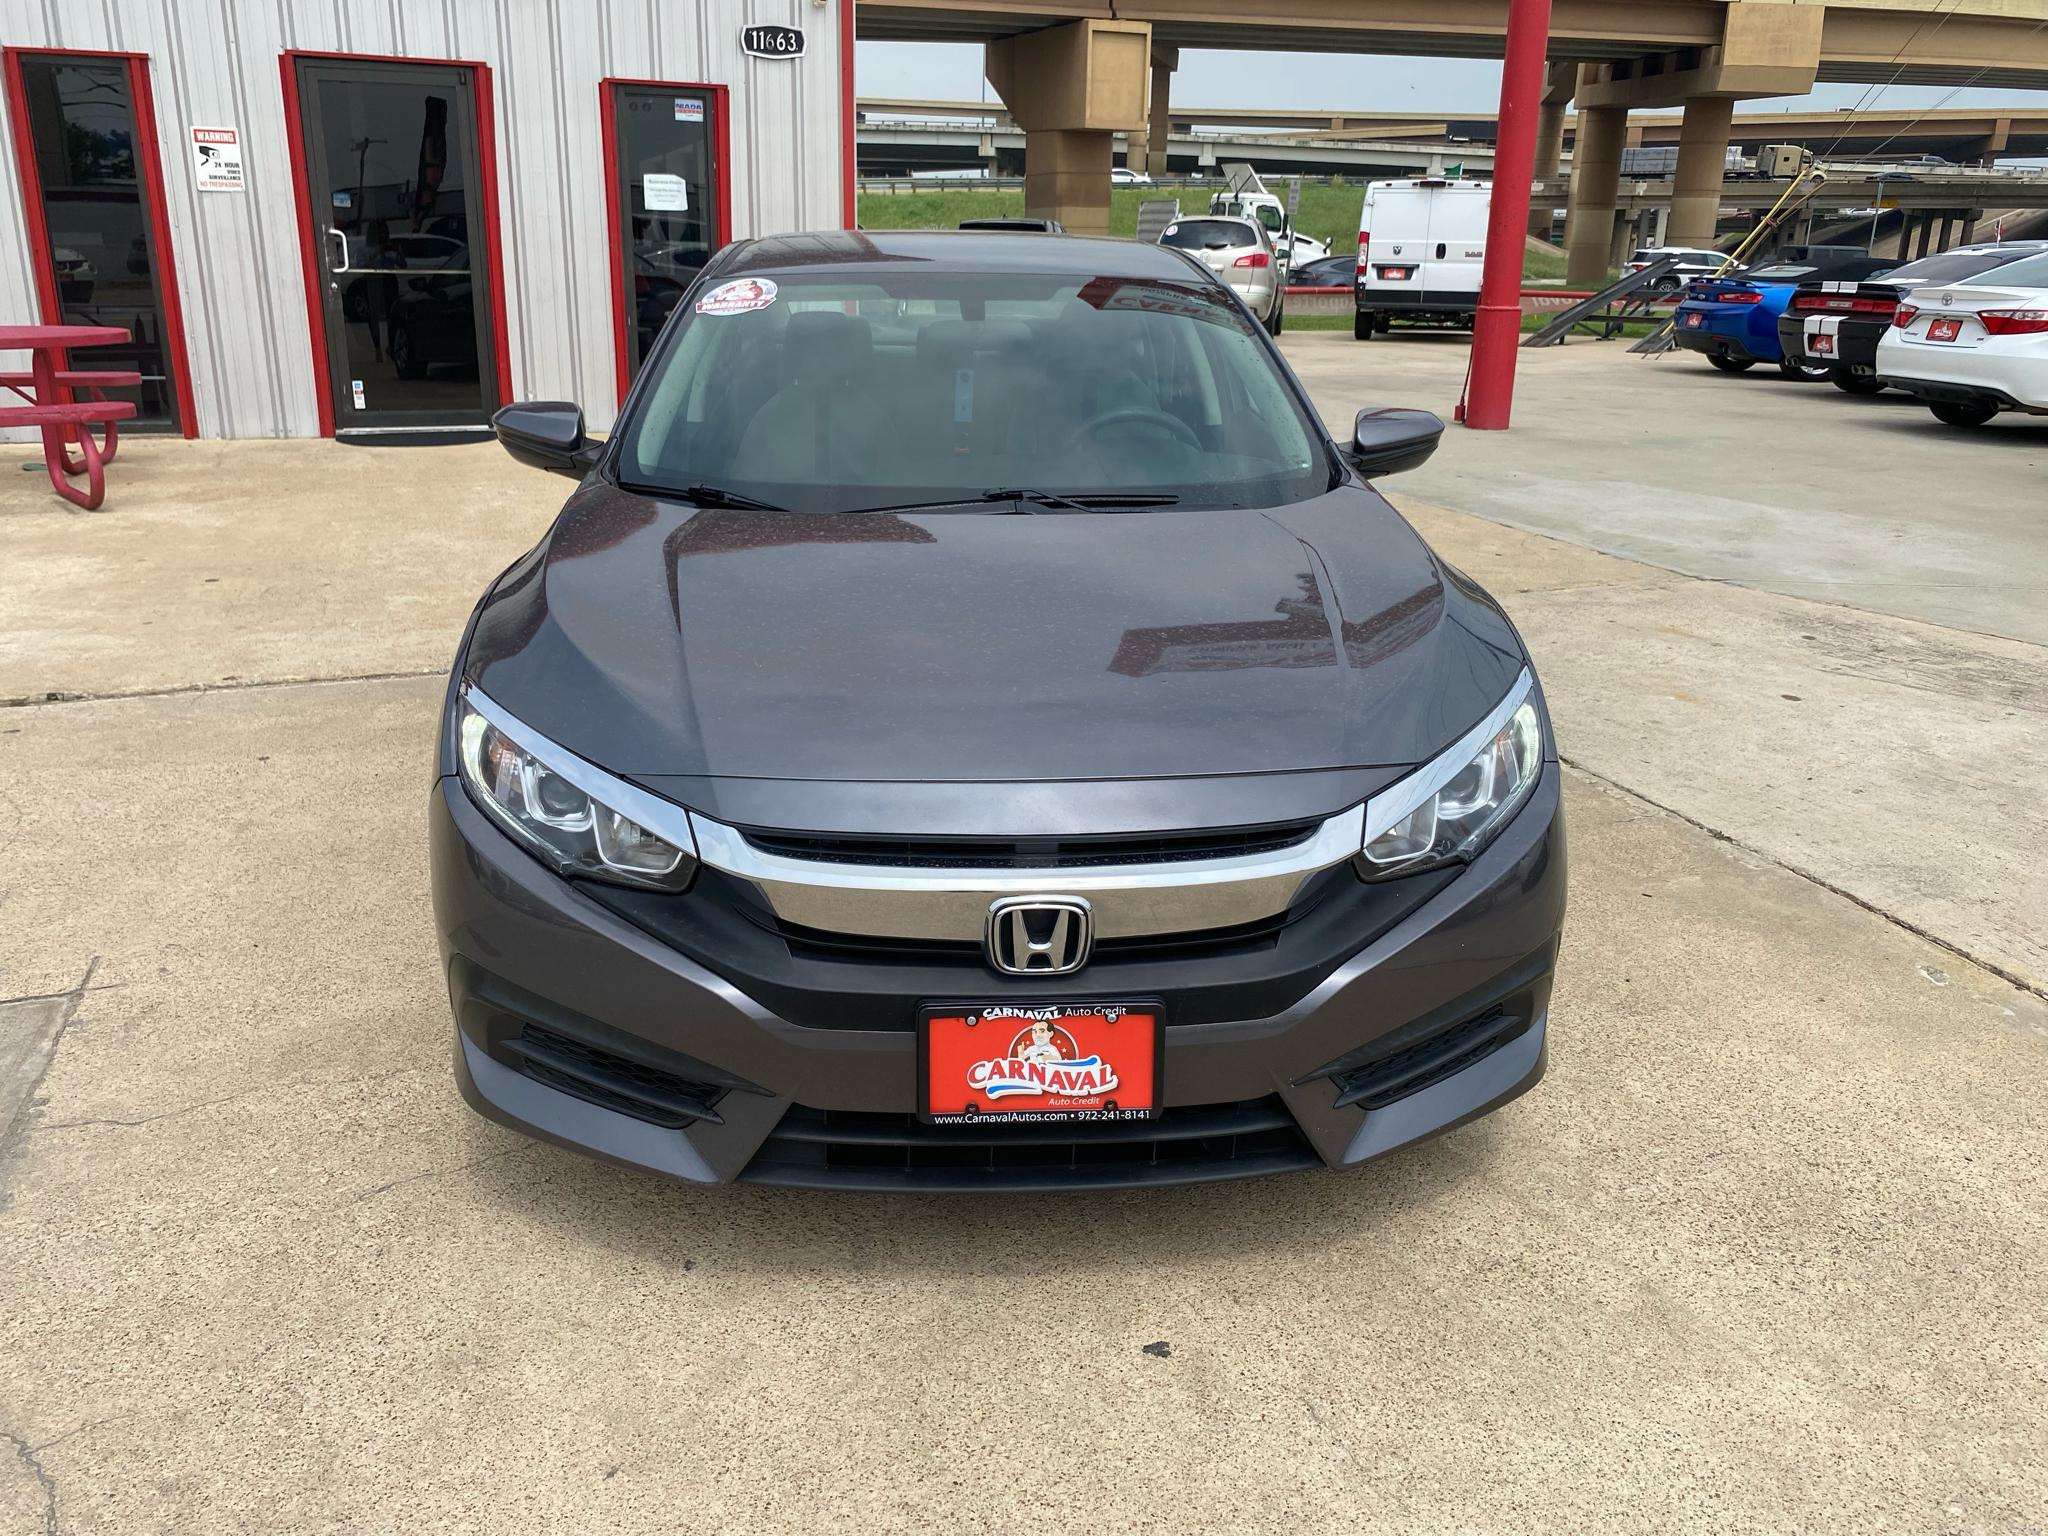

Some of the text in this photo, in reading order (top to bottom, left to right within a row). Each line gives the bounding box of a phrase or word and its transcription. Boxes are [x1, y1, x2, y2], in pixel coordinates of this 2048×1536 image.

[752, 30, 796, 51] 11663
[196, 131, 234, 142] WARNING
[702, 300, 765, 311] WARRANTY
[983, 1005, 1127, 1021] CARNAVAL Auto Credit
[967, 1057, 1119, 1096] CARNAVAL
[1048, 1096, 1101, 1106] Auto Credit
[934, 1109, 1150, 1124] www.CarnavalAutos.com 972-241-8141
